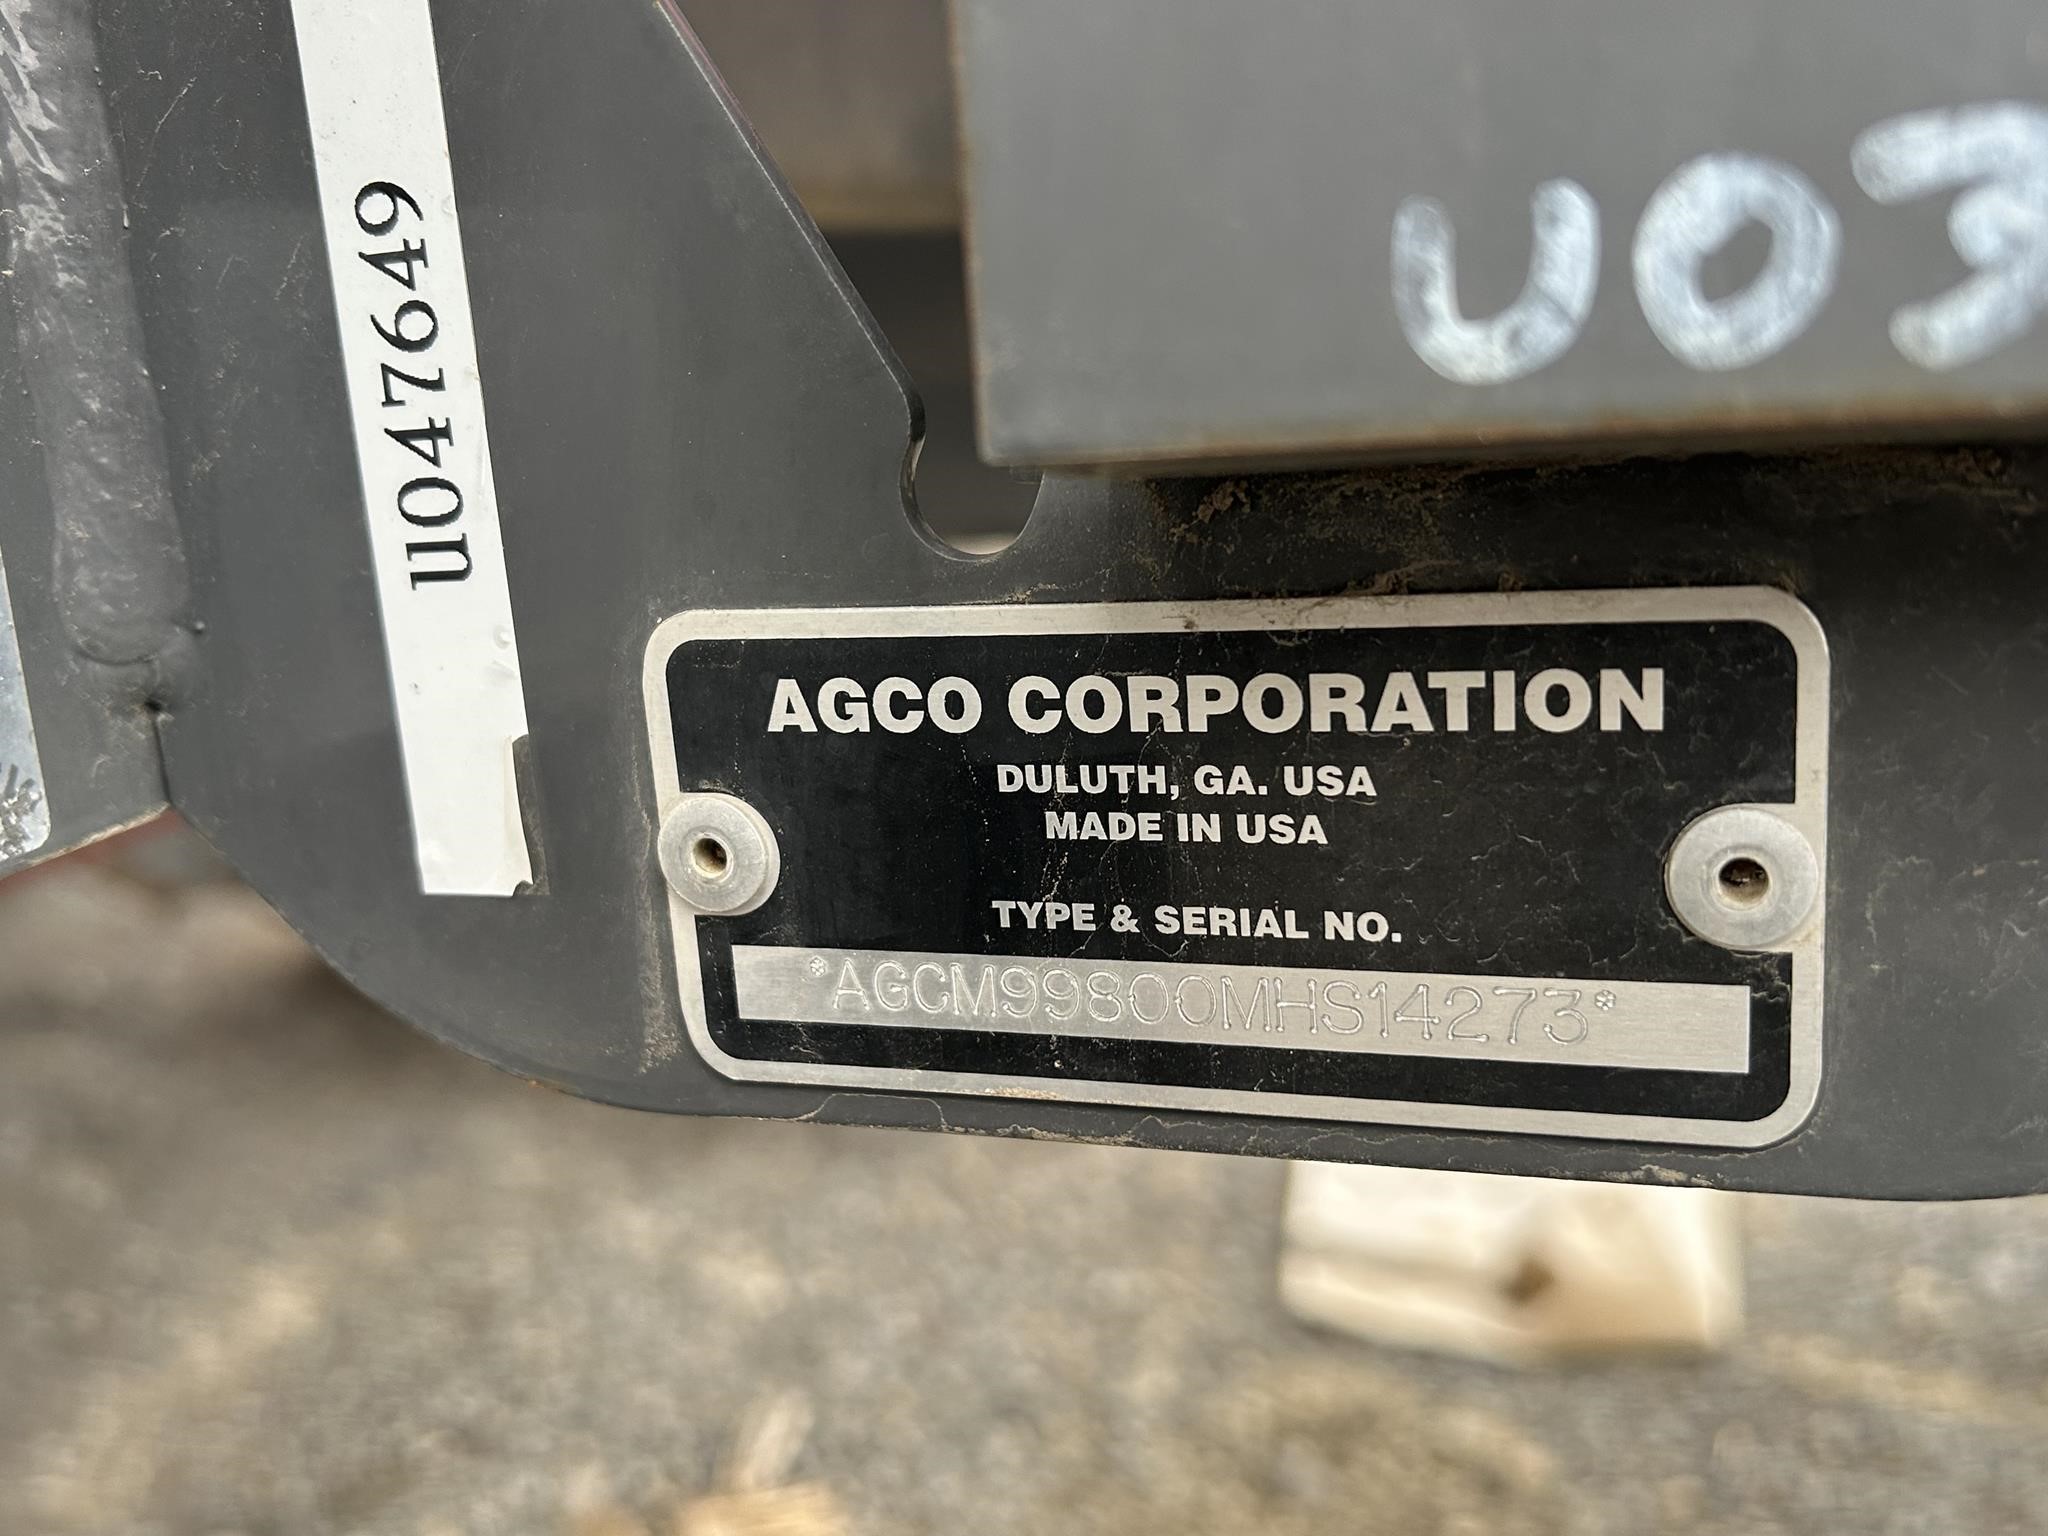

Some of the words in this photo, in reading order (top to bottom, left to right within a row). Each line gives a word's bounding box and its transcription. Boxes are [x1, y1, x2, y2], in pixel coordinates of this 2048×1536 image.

[768, 676, 982, 733] AGCO
[1008, 669, 1663, 734] CORPORATION
[997, 765, 1179, 800] DULUTH,
[1194, 765, 1267, 795] GA.
[1284, 766, 1377, 796] USA
[1045, 811, 1163, 842] MADE
[1177, 814, 1221, 842] IN
[1237, 814, 1328, 844] USA
[992, 900, 1096, 931] TYPE
[1111, 905, 1140, 933] &
[1155, 905, 1309, 939] SERIAL
[1325, 911, 1402, 943] NO.
